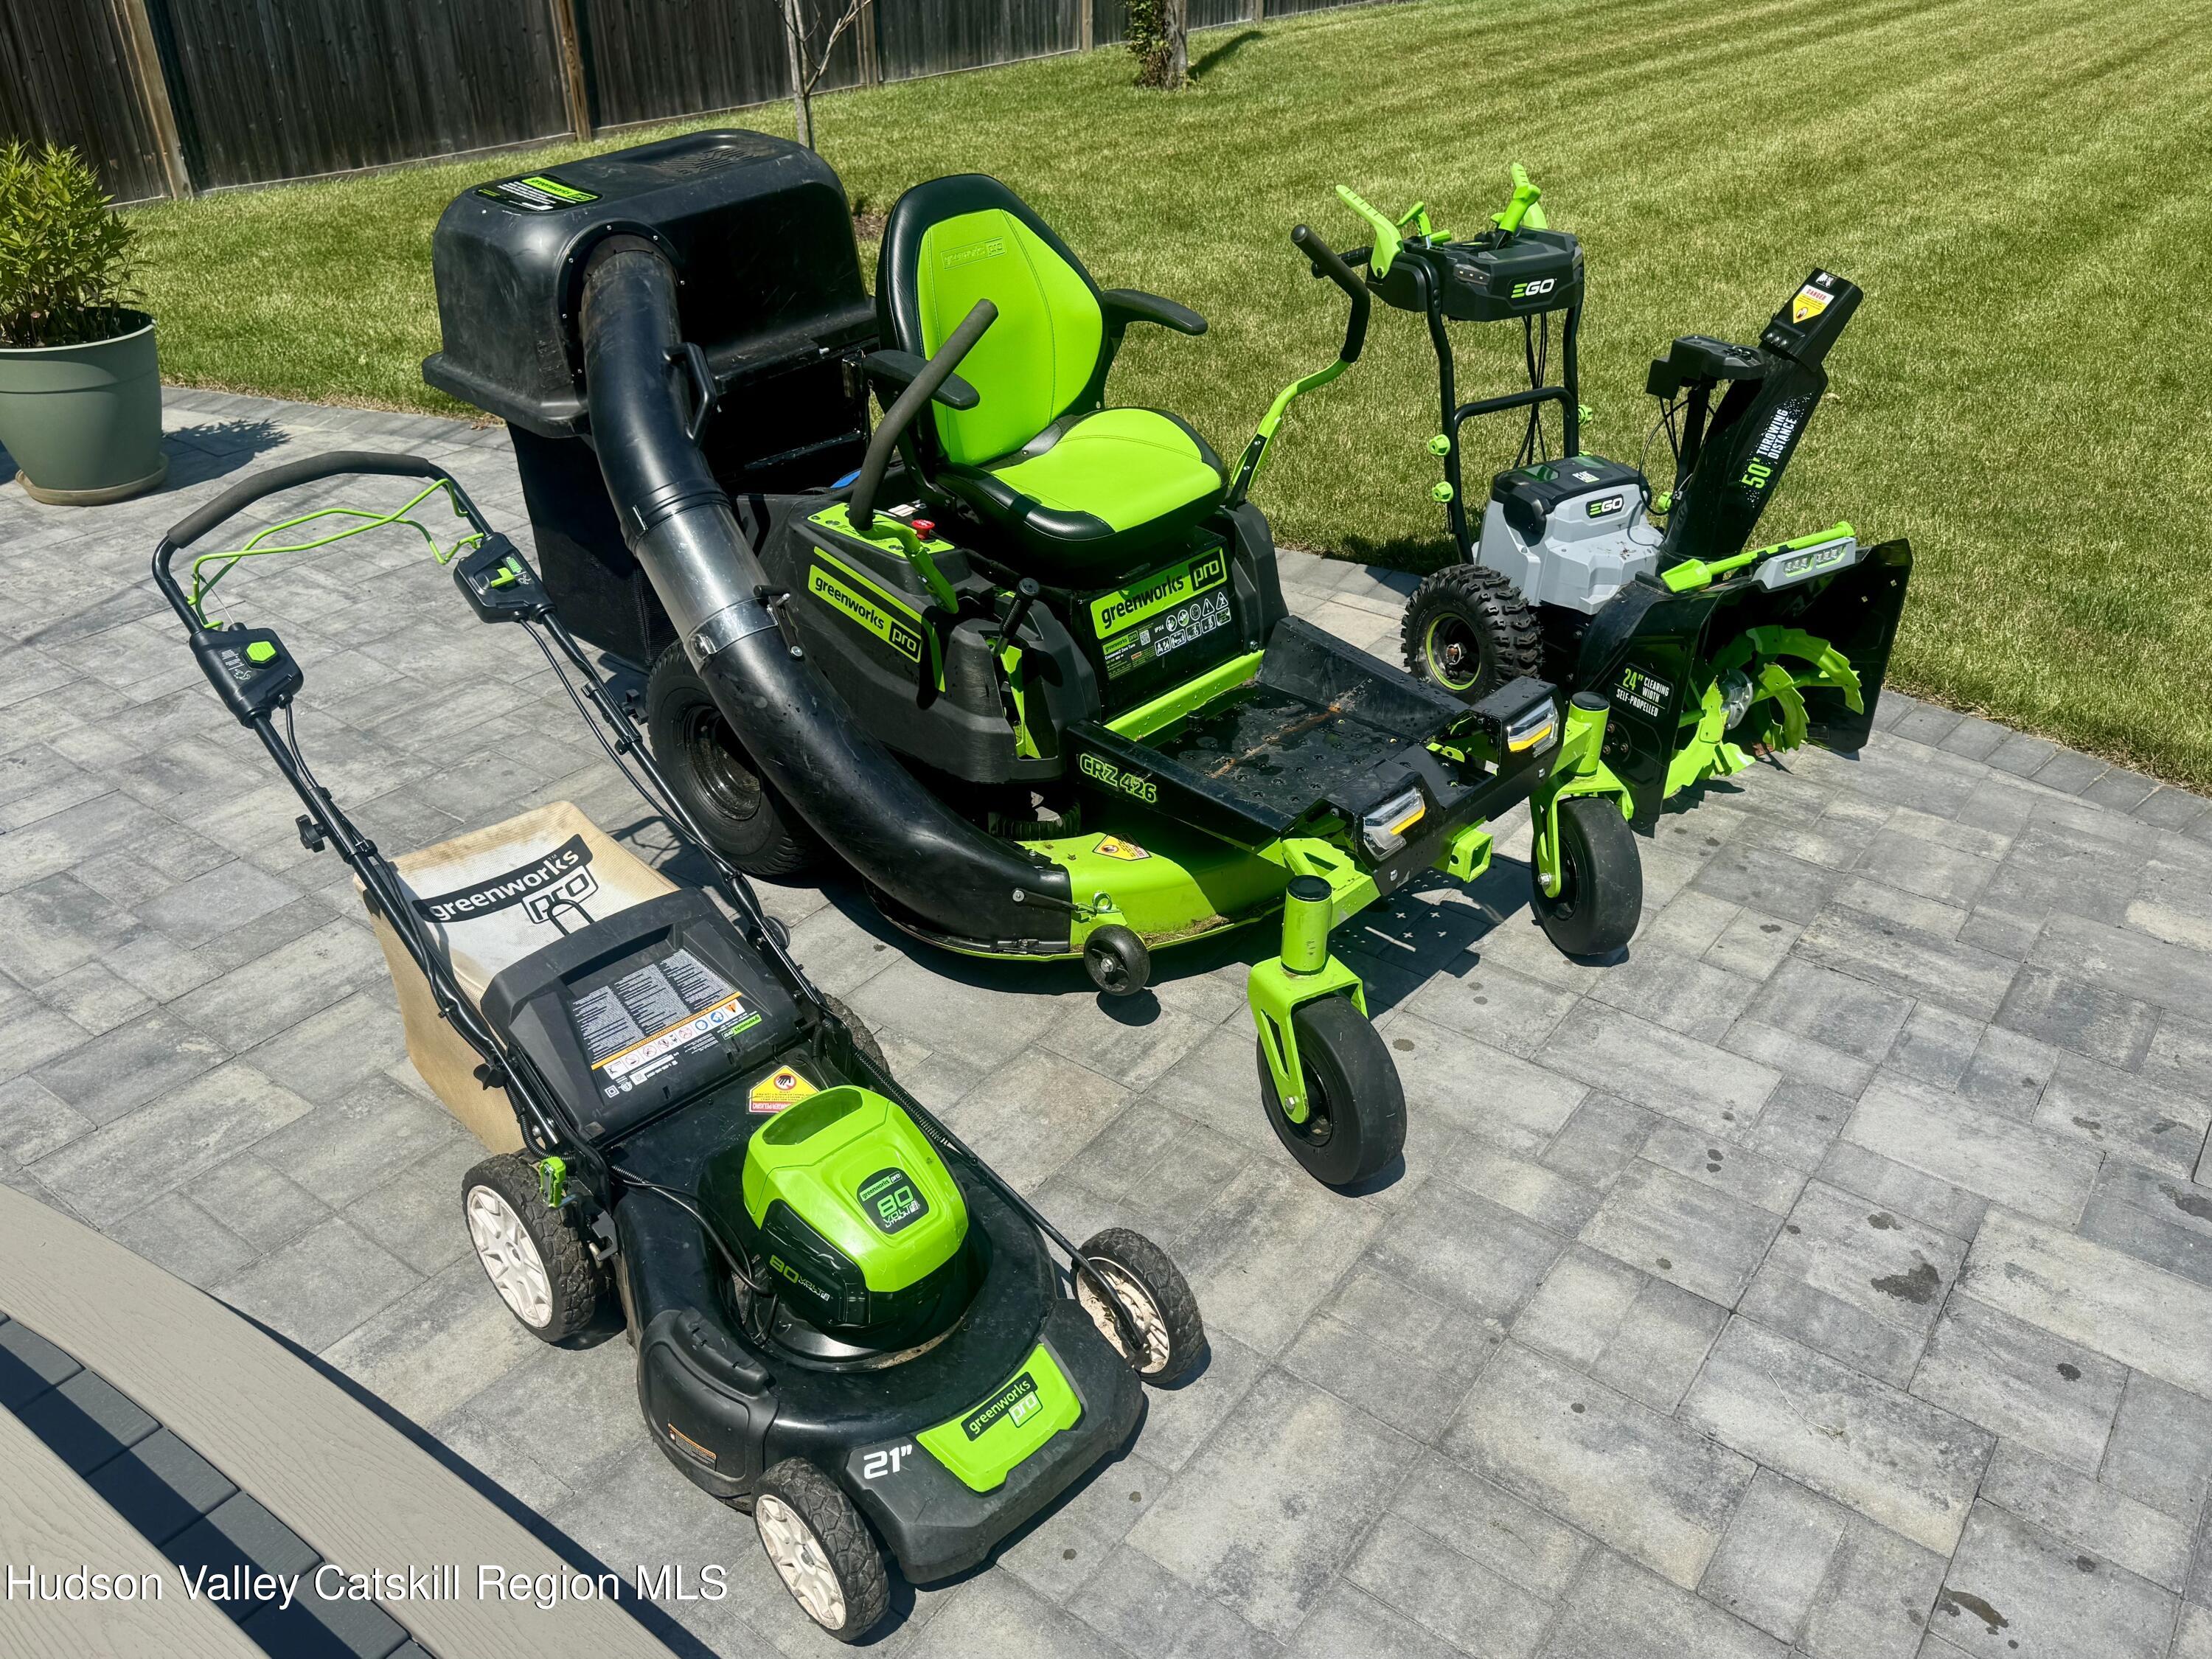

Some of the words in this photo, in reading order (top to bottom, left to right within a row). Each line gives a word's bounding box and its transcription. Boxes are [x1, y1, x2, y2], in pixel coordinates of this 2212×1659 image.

[1511, 278, 1555, 299] EGO
[1756, 408, 1788, 456] THROWING
[1767, 417, 1798, 460] DISTANCE
[1741, 456, 1771, 489] 50'
[1589, 497, 1623, 515] EGO
[1102, 574, 1184, 630] greenworks
[1192, 560, 1220, 588] pro
[815, 577, 885, 630] greenworks
[891, 627, 917, 653] pro
[1622, 667, 1644, 691] 24"
[1644, 677, 1669, 697] CLEARING
[1642, 686, 1660, 703] WIDTH
[1615, 688, 1659, 717] SELF-PROPELLED
[1079, 753, 1119, 787] CRZ
[1119, 773, 1157, 803] 426
[428, 849, 579, 921] greenworks
[862, 1179, 890, 1199] greenworks
[890, 1173, 900, 1183] pro
[877, 1185, 914, 1218] 80
[883, 1203, 911, 1223] VOLT
[770, 1254, 799, 1284] 80
[800, 1276, 825, 1293] VOLT
[969, 1380, 1031, 1435] greenworks
[1011, 1394, 1037, 1426] pro
[863, 1444, 913, 1480] 21"
